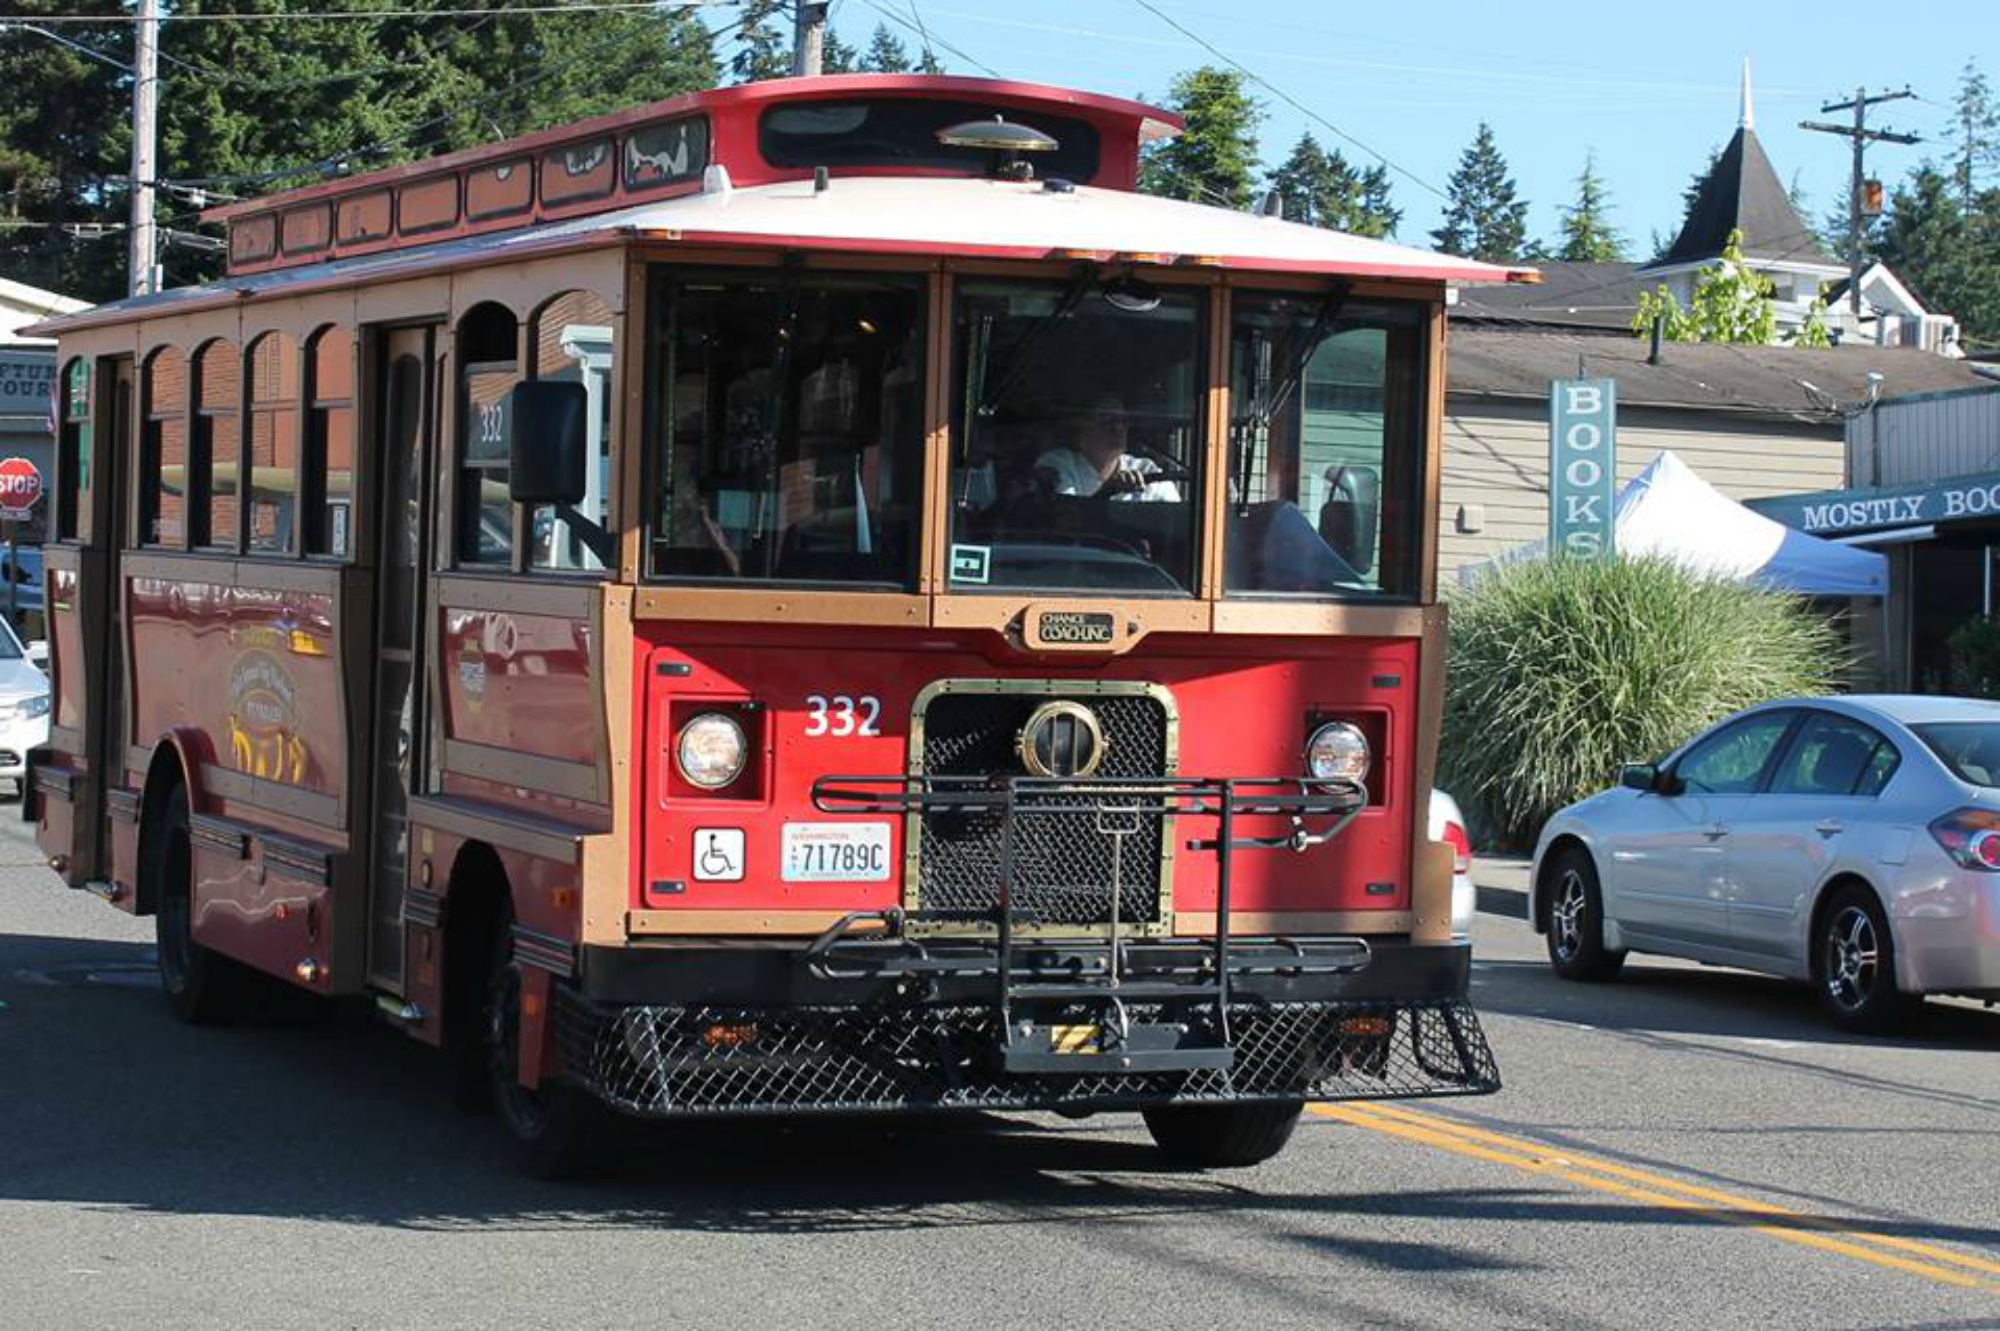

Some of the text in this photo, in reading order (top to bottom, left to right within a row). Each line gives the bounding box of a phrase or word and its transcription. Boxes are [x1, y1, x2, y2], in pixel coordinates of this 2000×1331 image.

[481, 405, 503, 442] 332
[1565, 386, 1603, 560] BOOKS
[1802, 495, 1926, 531] MOSTLY
[804, 694, 882, 737] 332
[802, 843, 883, 872] 71789C
